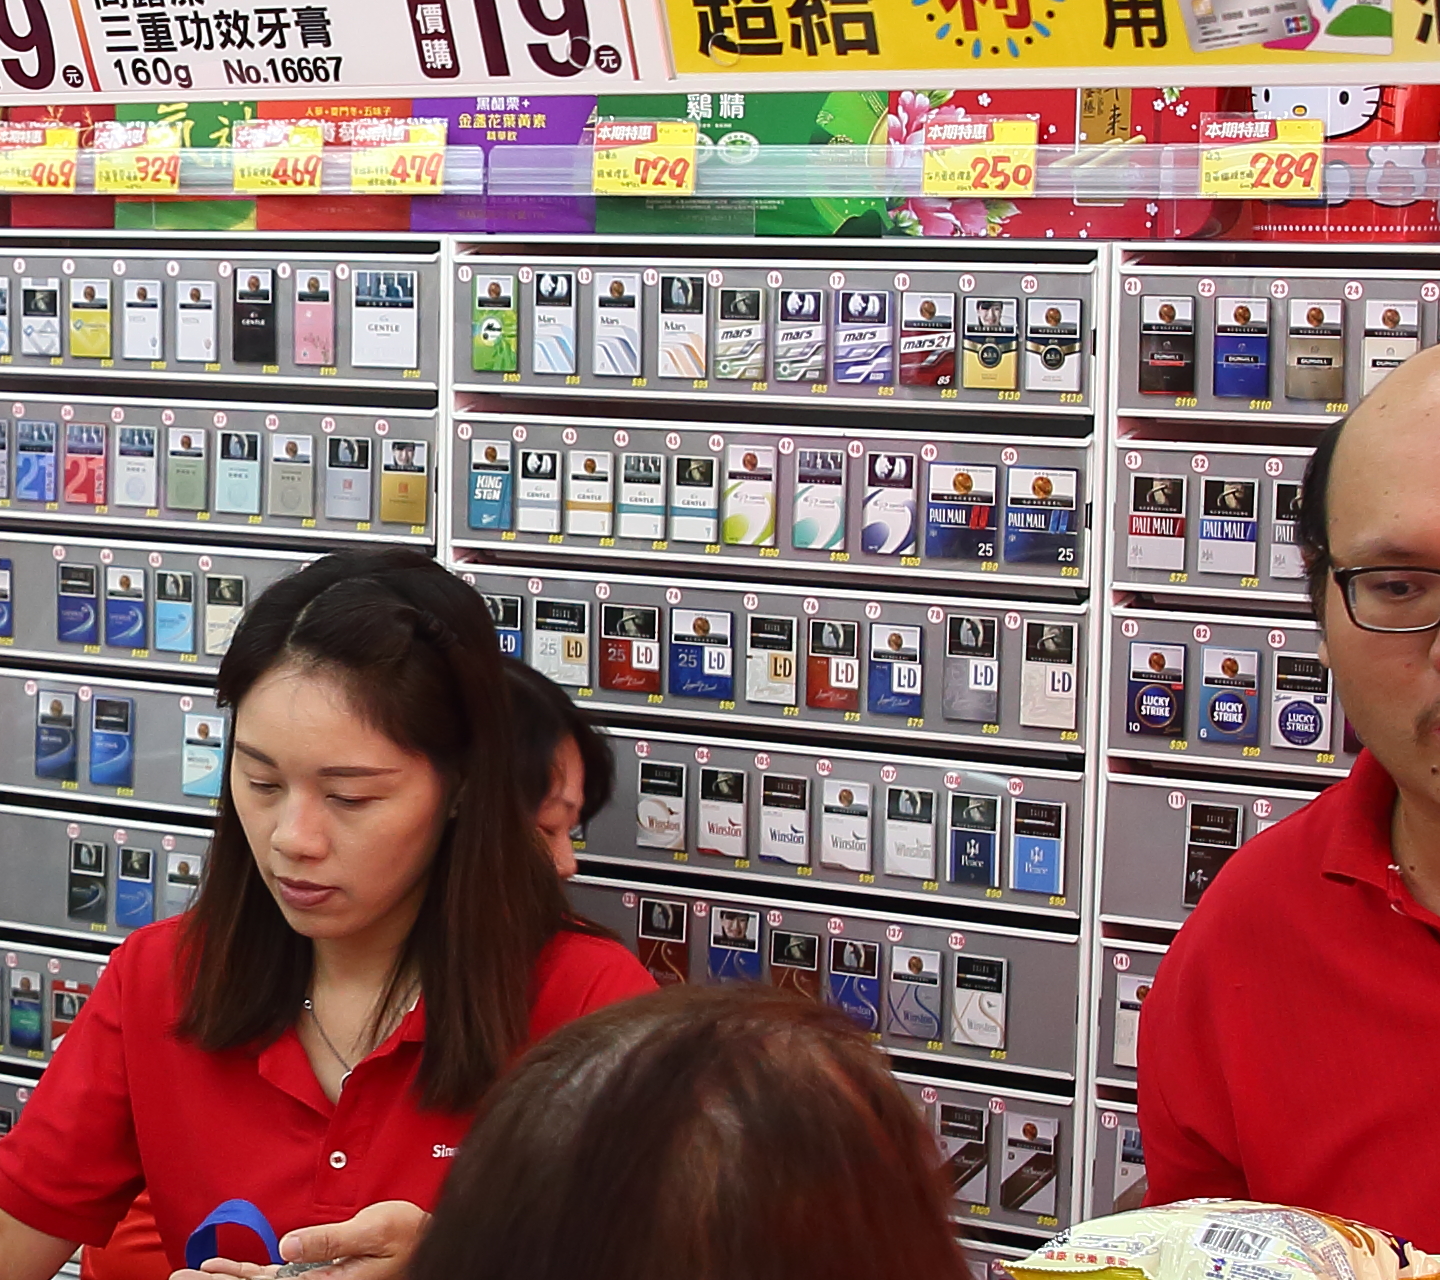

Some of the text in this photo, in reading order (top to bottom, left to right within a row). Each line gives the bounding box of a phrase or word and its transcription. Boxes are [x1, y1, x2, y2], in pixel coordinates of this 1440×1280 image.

[98, 6, 334, 56] 三重功效牙膏
[113, 55, 342, 91] 160g No.16667
[926, 123, 987, 141] 本期特惠
[1204, 122, 1271, 139] 本期特惠
[390, 153, 441, 186] 479
[634, 154, 688, 188] 729
[971, 154, 1032, 190] 250
[1250, 152, 1318, 190] 289
[976, 542, 993, 556] 25
[1058, 548, 1074, 561] 25
[1138, 703, 1174, 718] STRIKE
[1140, 692, 1173, 705] LUCKY
